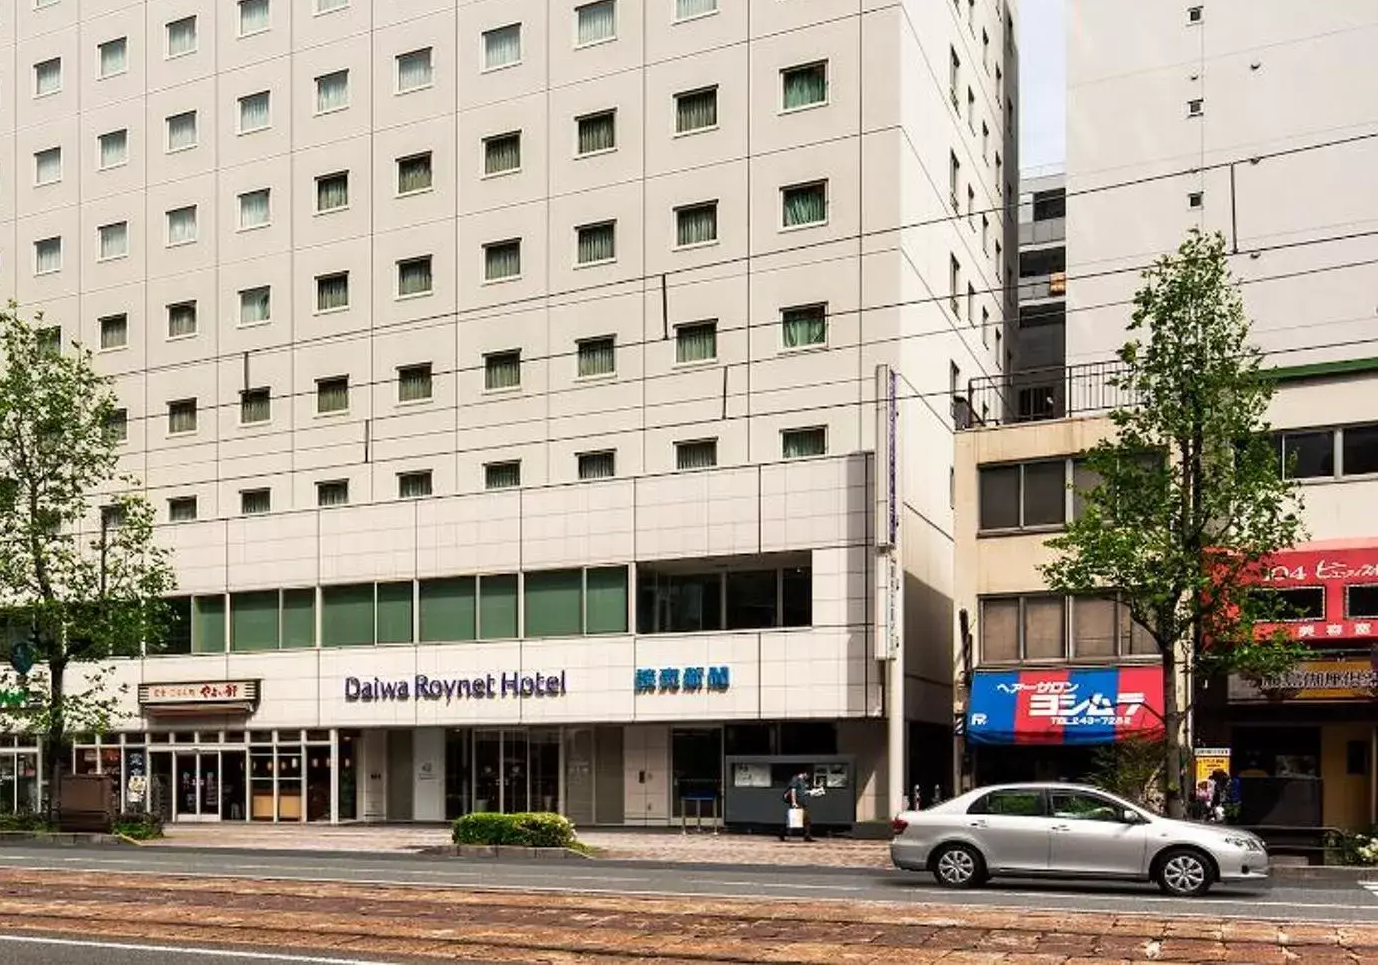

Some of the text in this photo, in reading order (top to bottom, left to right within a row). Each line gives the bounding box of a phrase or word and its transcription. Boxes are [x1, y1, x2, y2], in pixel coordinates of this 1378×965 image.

[345, 670, 567, 707] Daiwa Roynet Hotel
[1029, 692, 1146, 717] ヨシムラ
